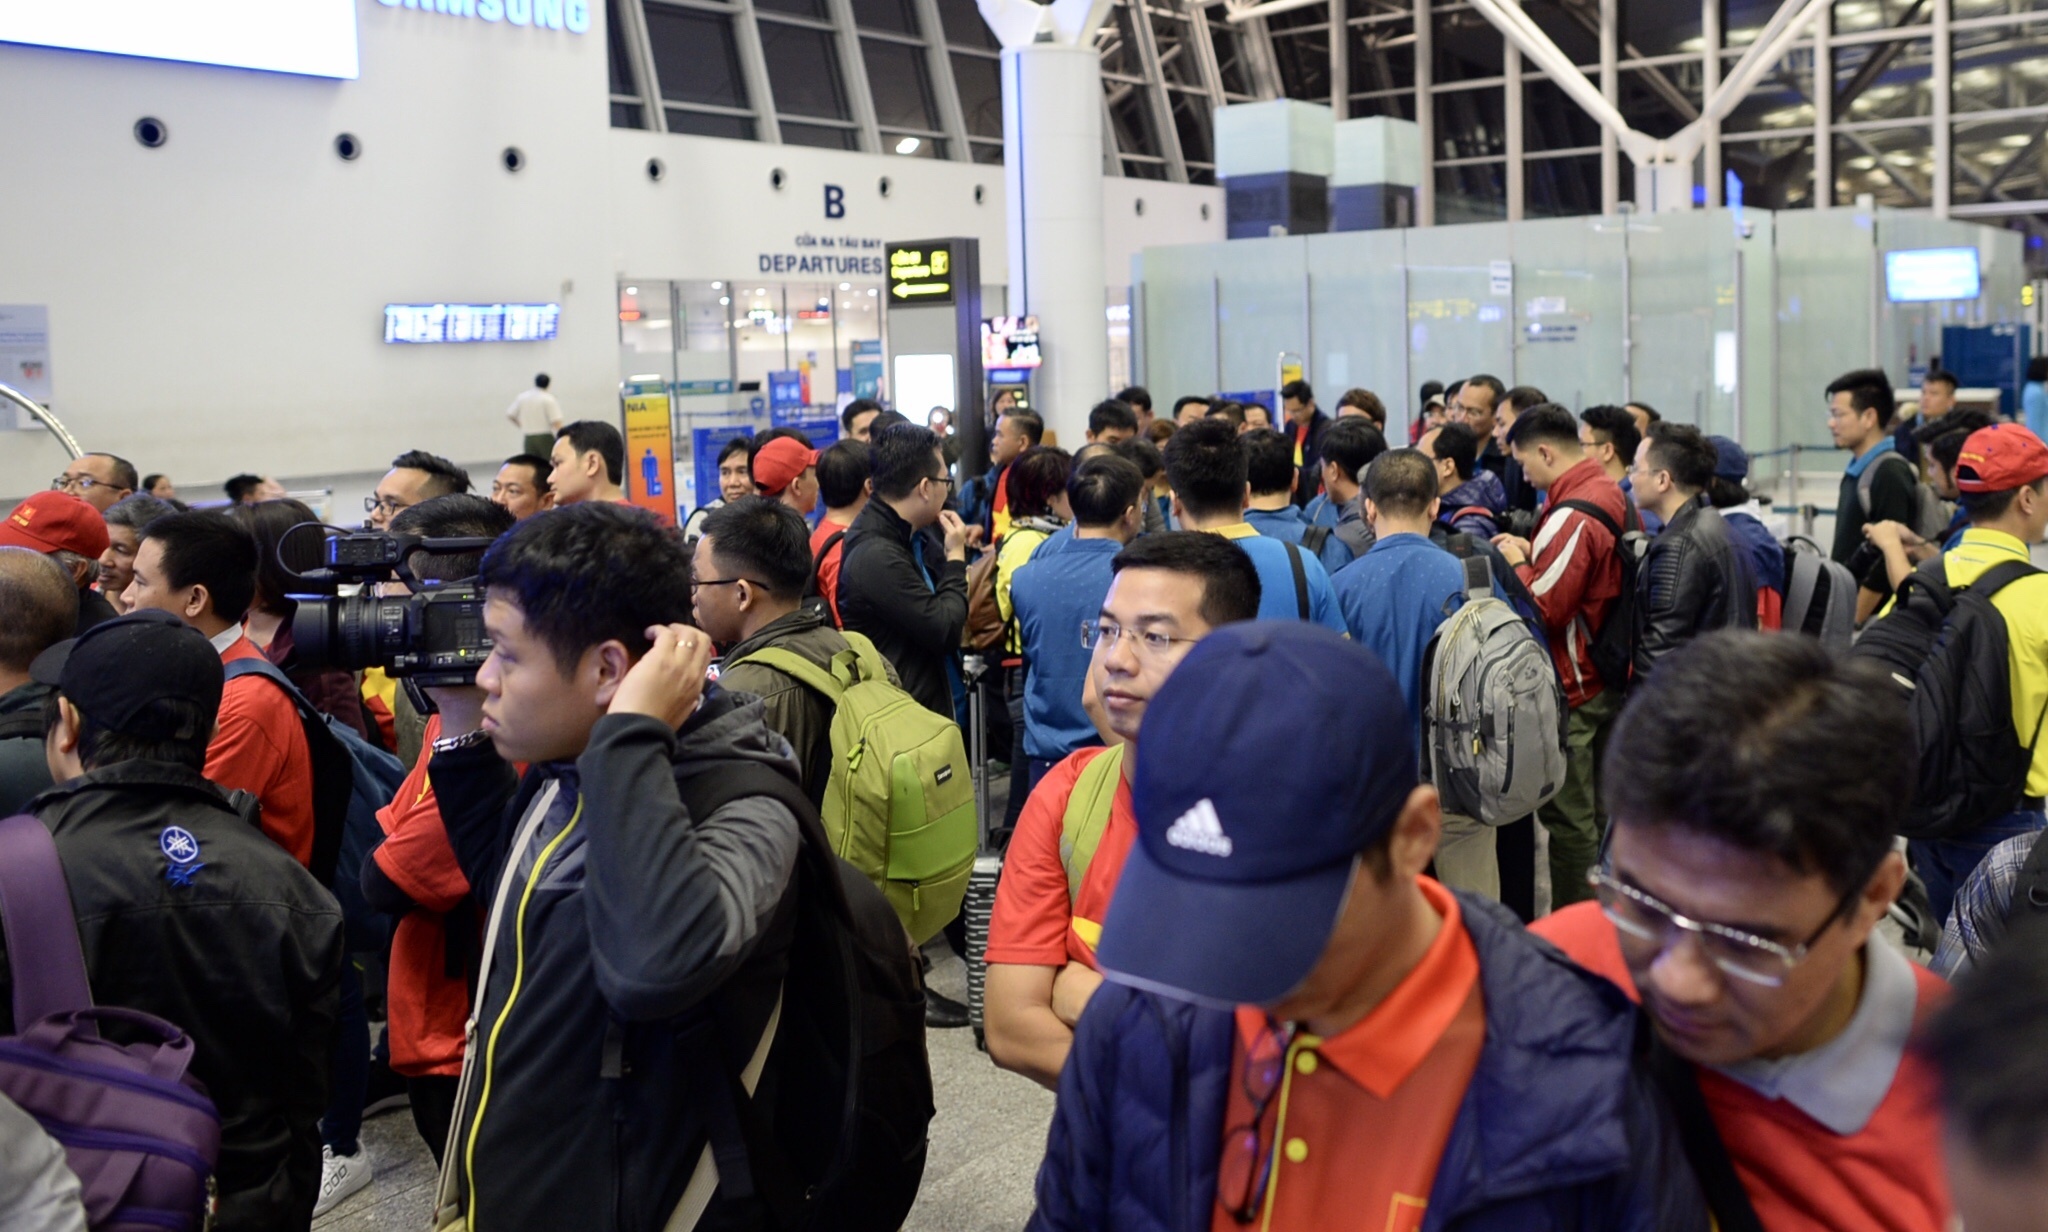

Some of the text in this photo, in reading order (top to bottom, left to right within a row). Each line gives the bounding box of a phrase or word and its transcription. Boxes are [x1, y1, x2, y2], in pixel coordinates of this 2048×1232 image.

[376, 0, 591, 34] SUNG
[824, 184, 845, 219] B
[759, 254, 882, 274] DEPARTURES
